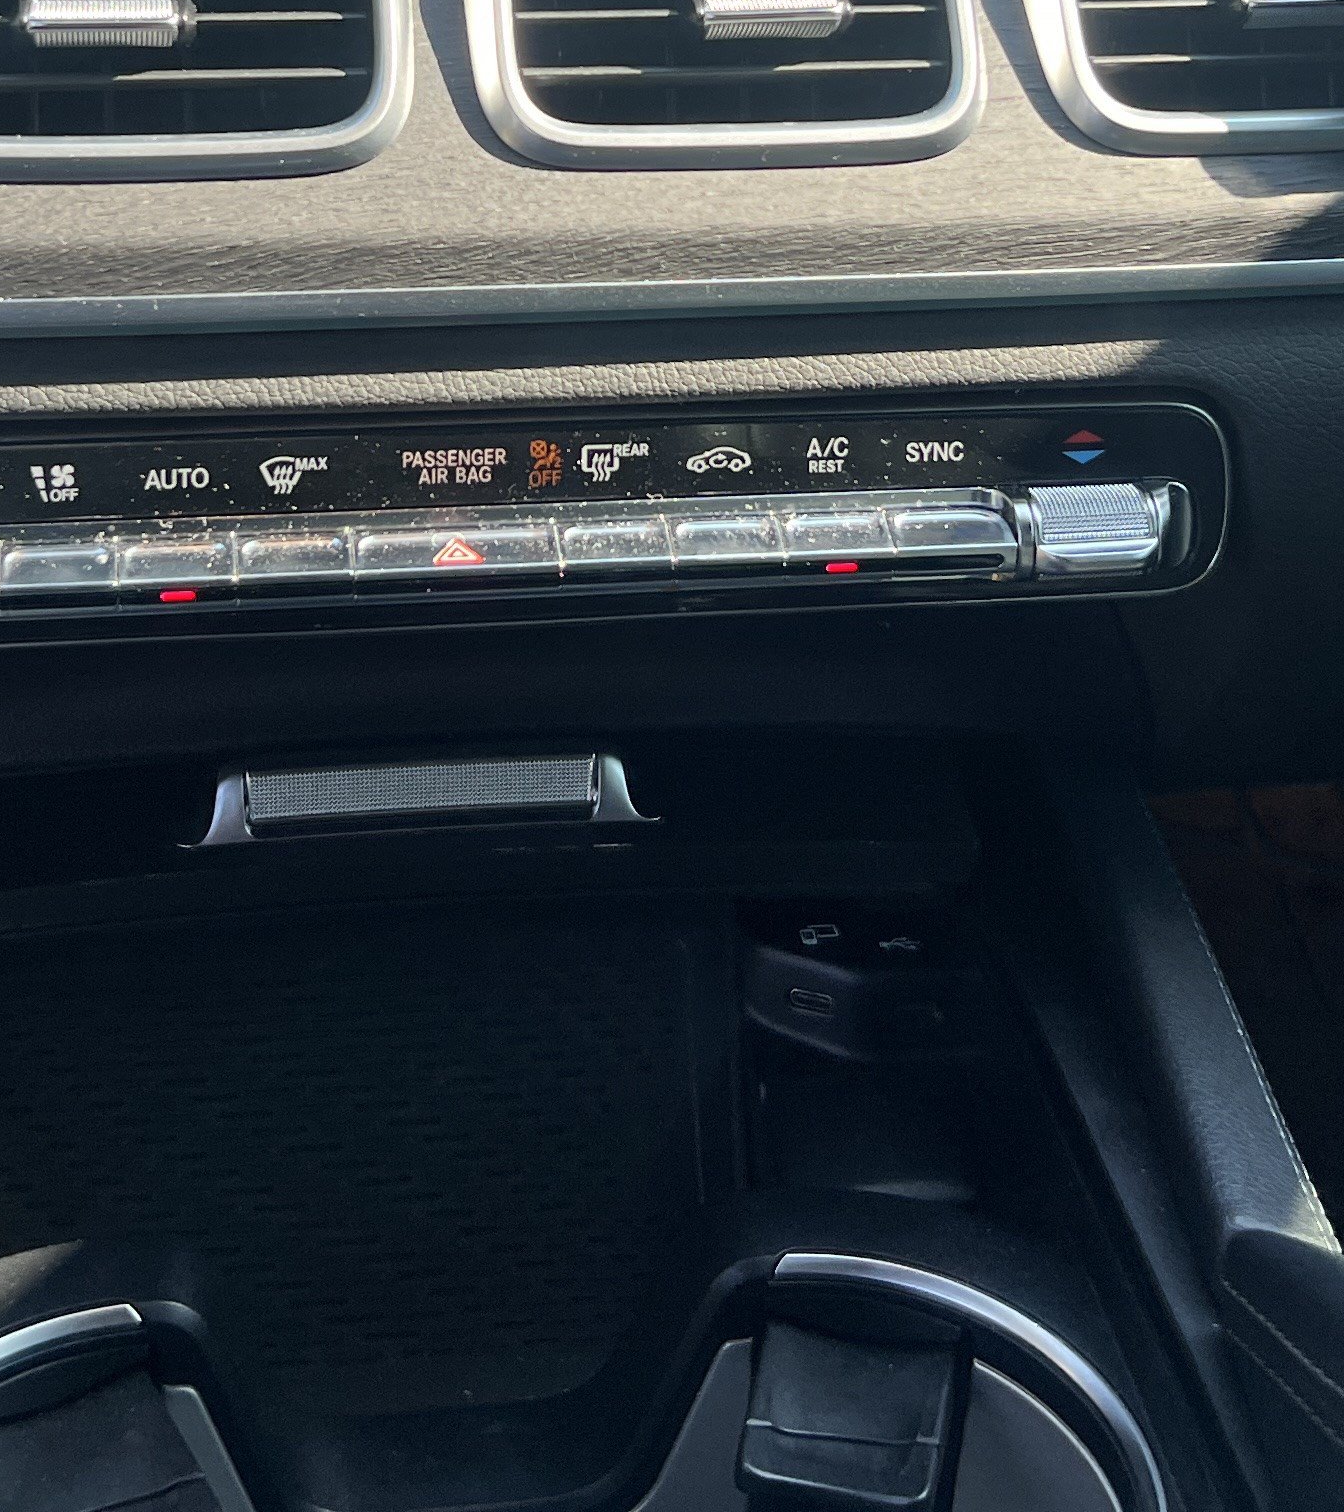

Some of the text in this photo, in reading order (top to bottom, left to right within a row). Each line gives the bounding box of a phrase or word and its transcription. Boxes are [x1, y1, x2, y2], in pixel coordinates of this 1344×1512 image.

[613, 442, 649, 457] REAR
[807, 436, 849, 458] A/C
[905, 440, 965, 463] SYNC
[294, 456, 328, 471] MAX
[402, 447, 506, 469] PASSENGER
[808, 459, 845, 474] REST
[144, 467, 210, 491] AUTO
[418, 465, 492, 486] AIR BAG
[528, 469, 563, 487] OFF
[49, 488, 80, 503] OFF
